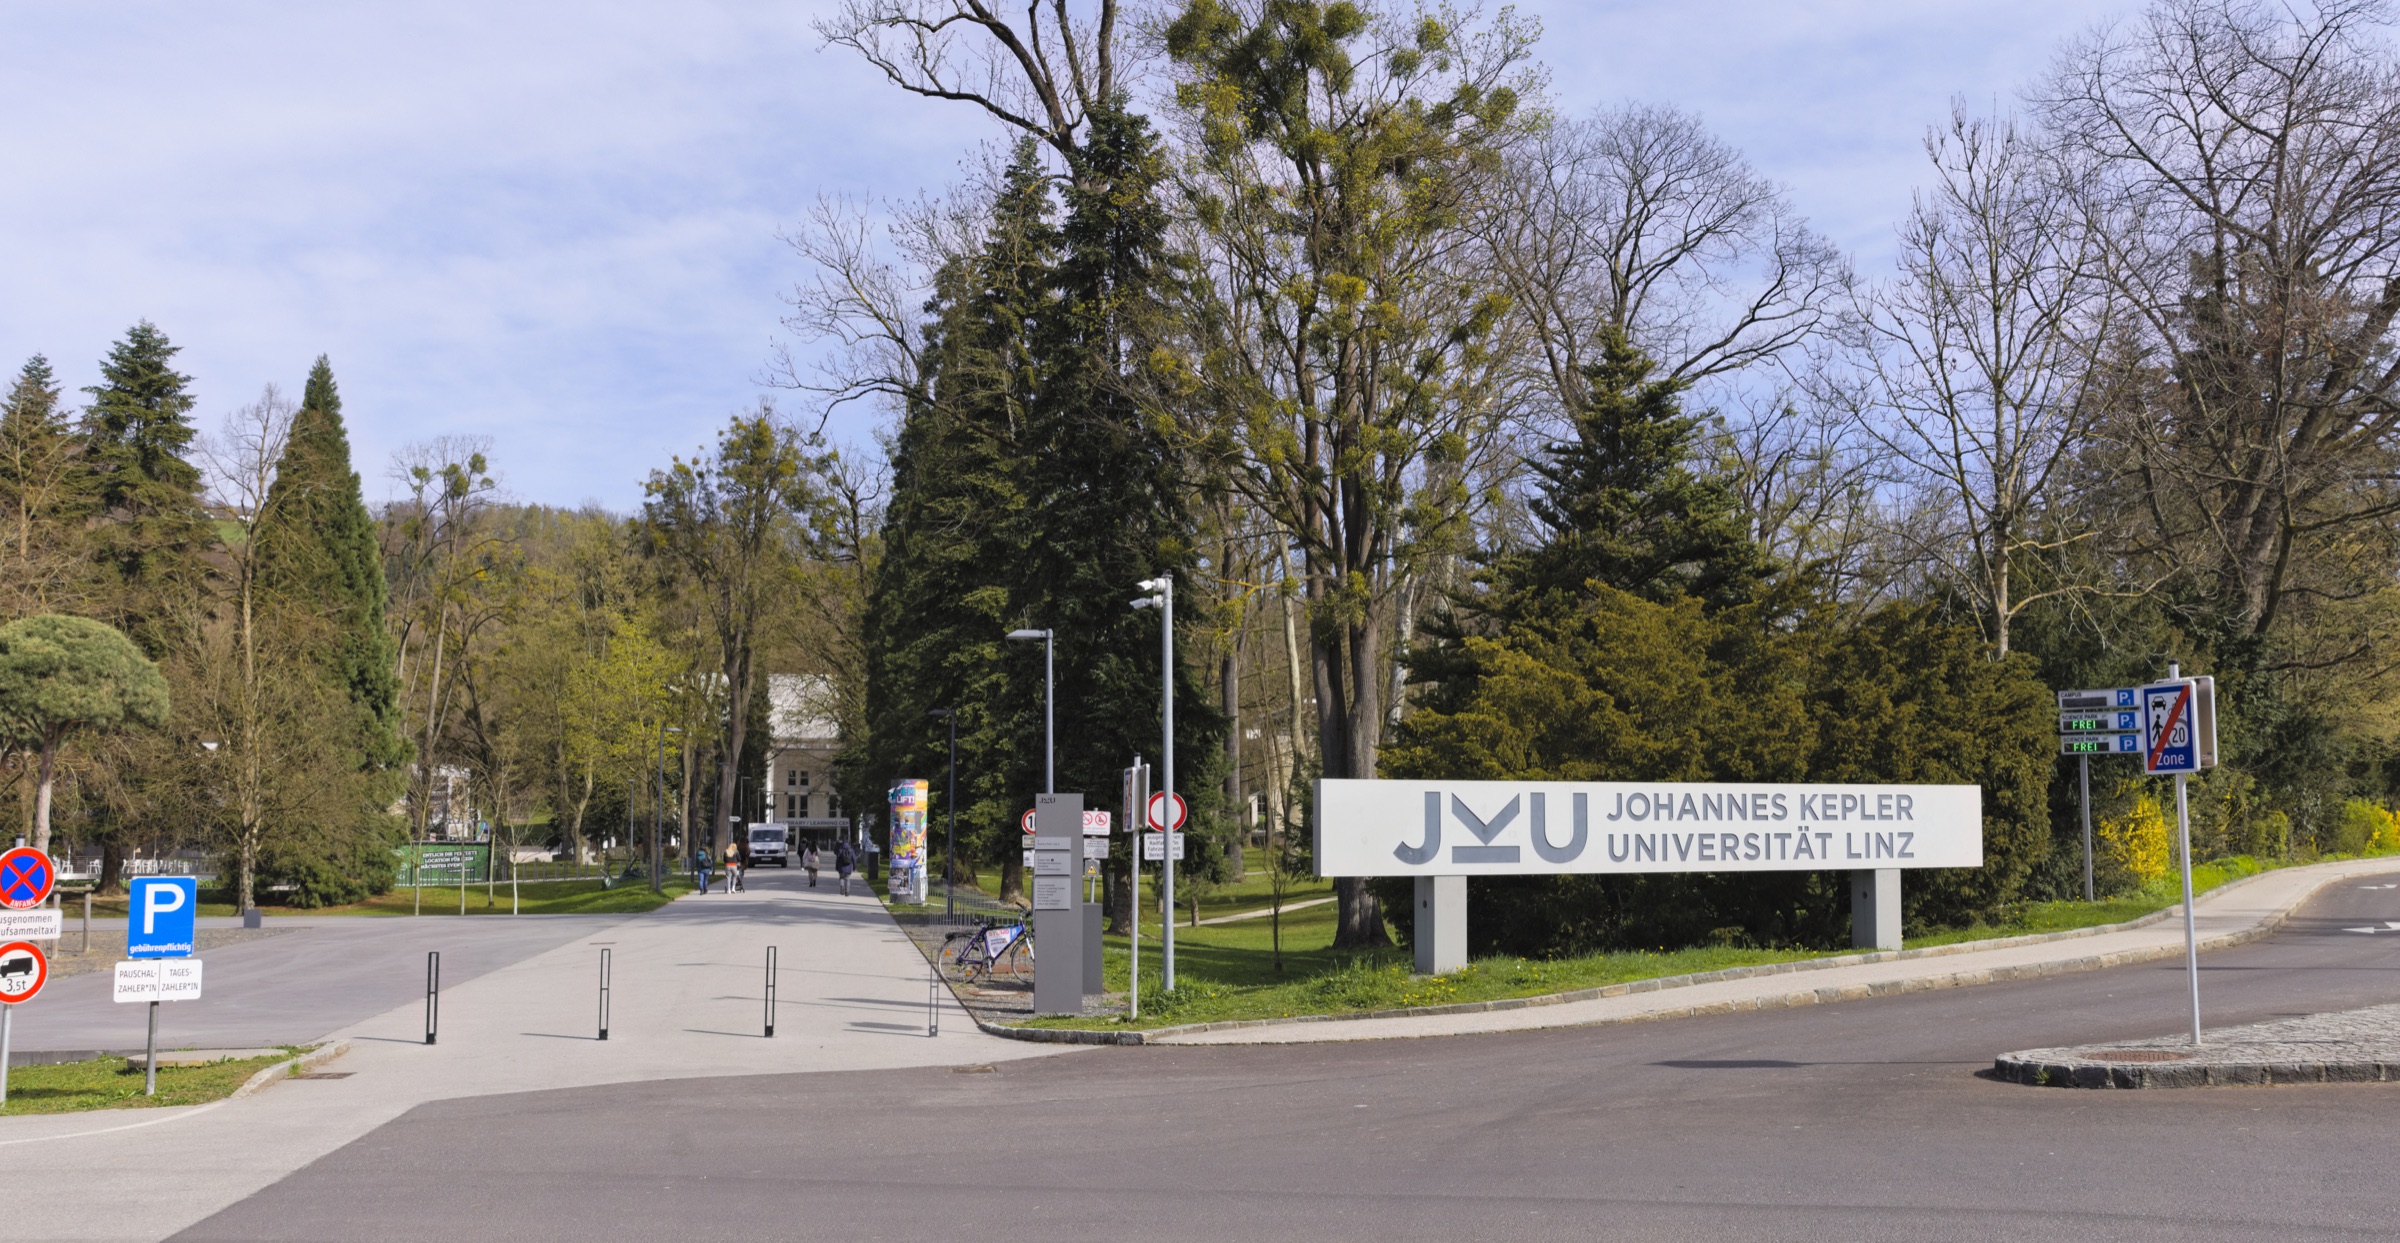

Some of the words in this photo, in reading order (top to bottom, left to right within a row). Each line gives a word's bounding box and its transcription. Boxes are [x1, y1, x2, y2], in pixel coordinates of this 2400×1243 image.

[2072, 720, 2096, 730] FREI
[2172, 728, 2186, 743] 20
[2073, 742, 2097, 752] FREI
[2124, 739, 2134, 751] P
[2156, 752, 2185, 766] Zone
[1606, 791, 1788, 821] JOHANNES
[1799, 793, 1914, 821] KEPLER
[1607, 825, 1833, 862] UNIVERSITÄT
[1846, 831, 1915, 860] LINZ
[9, 899, 36, 908] ANFANG
[143, 883, 186, 934] P
[129, 942, 192, 954] gebührenpflichtig
[119, 970, 157, 978] PAUSCHAL-
[169, 968, 192, 976] TAGES-
